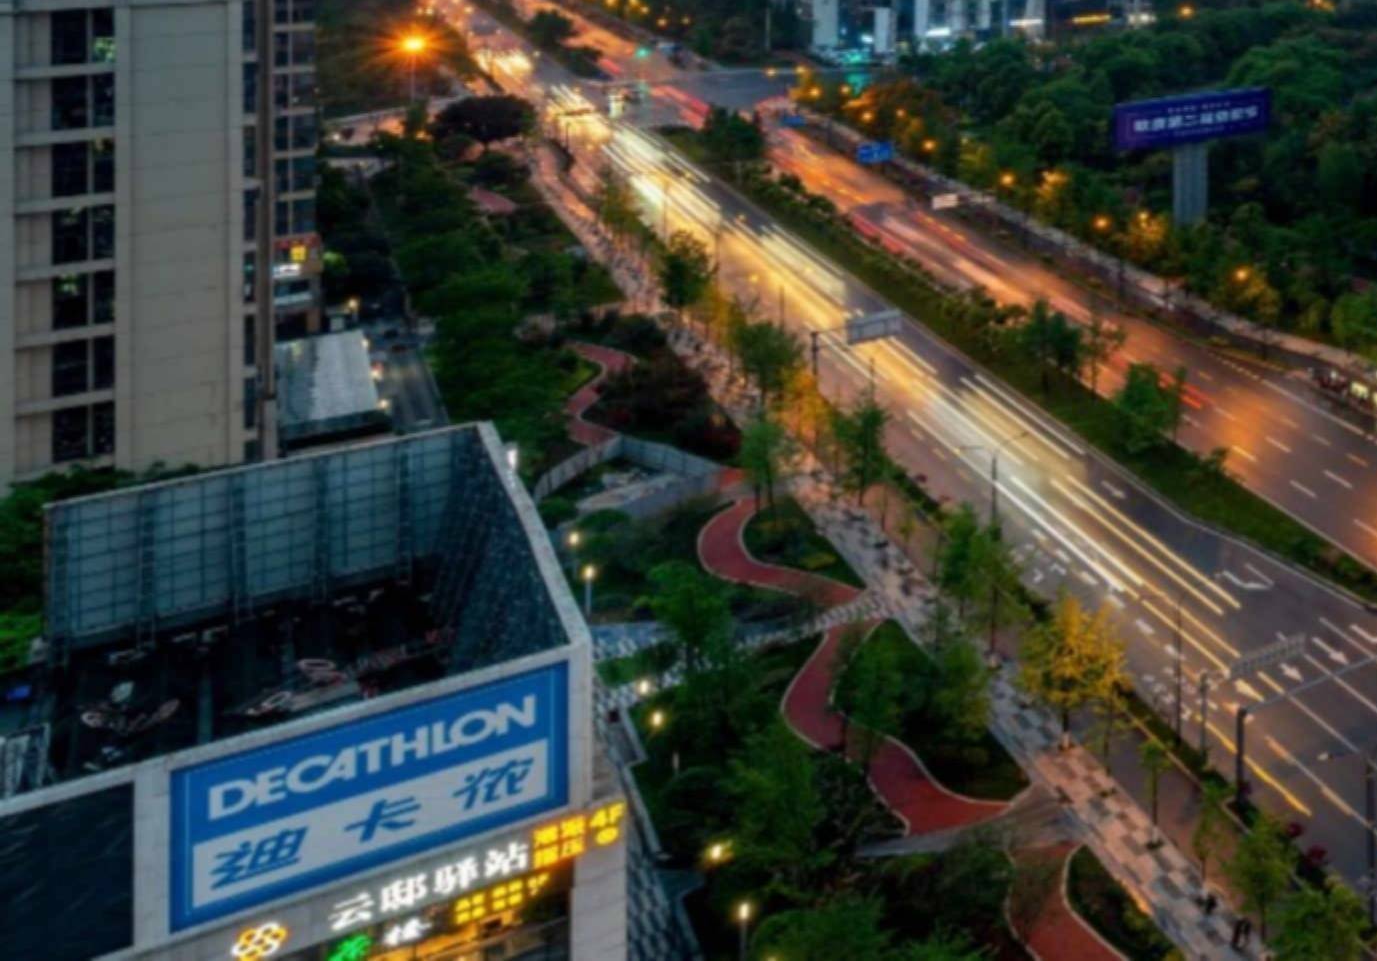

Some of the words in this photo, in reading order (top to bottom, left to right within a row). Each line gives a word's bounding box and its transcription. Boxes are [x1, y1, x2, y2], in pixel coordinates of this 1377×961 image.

[208, 695, 537, 821] DECATHLON
[210, 756, 535, 891] 迪卡侬
[328, 840, 530, 931] 云邸驿站
